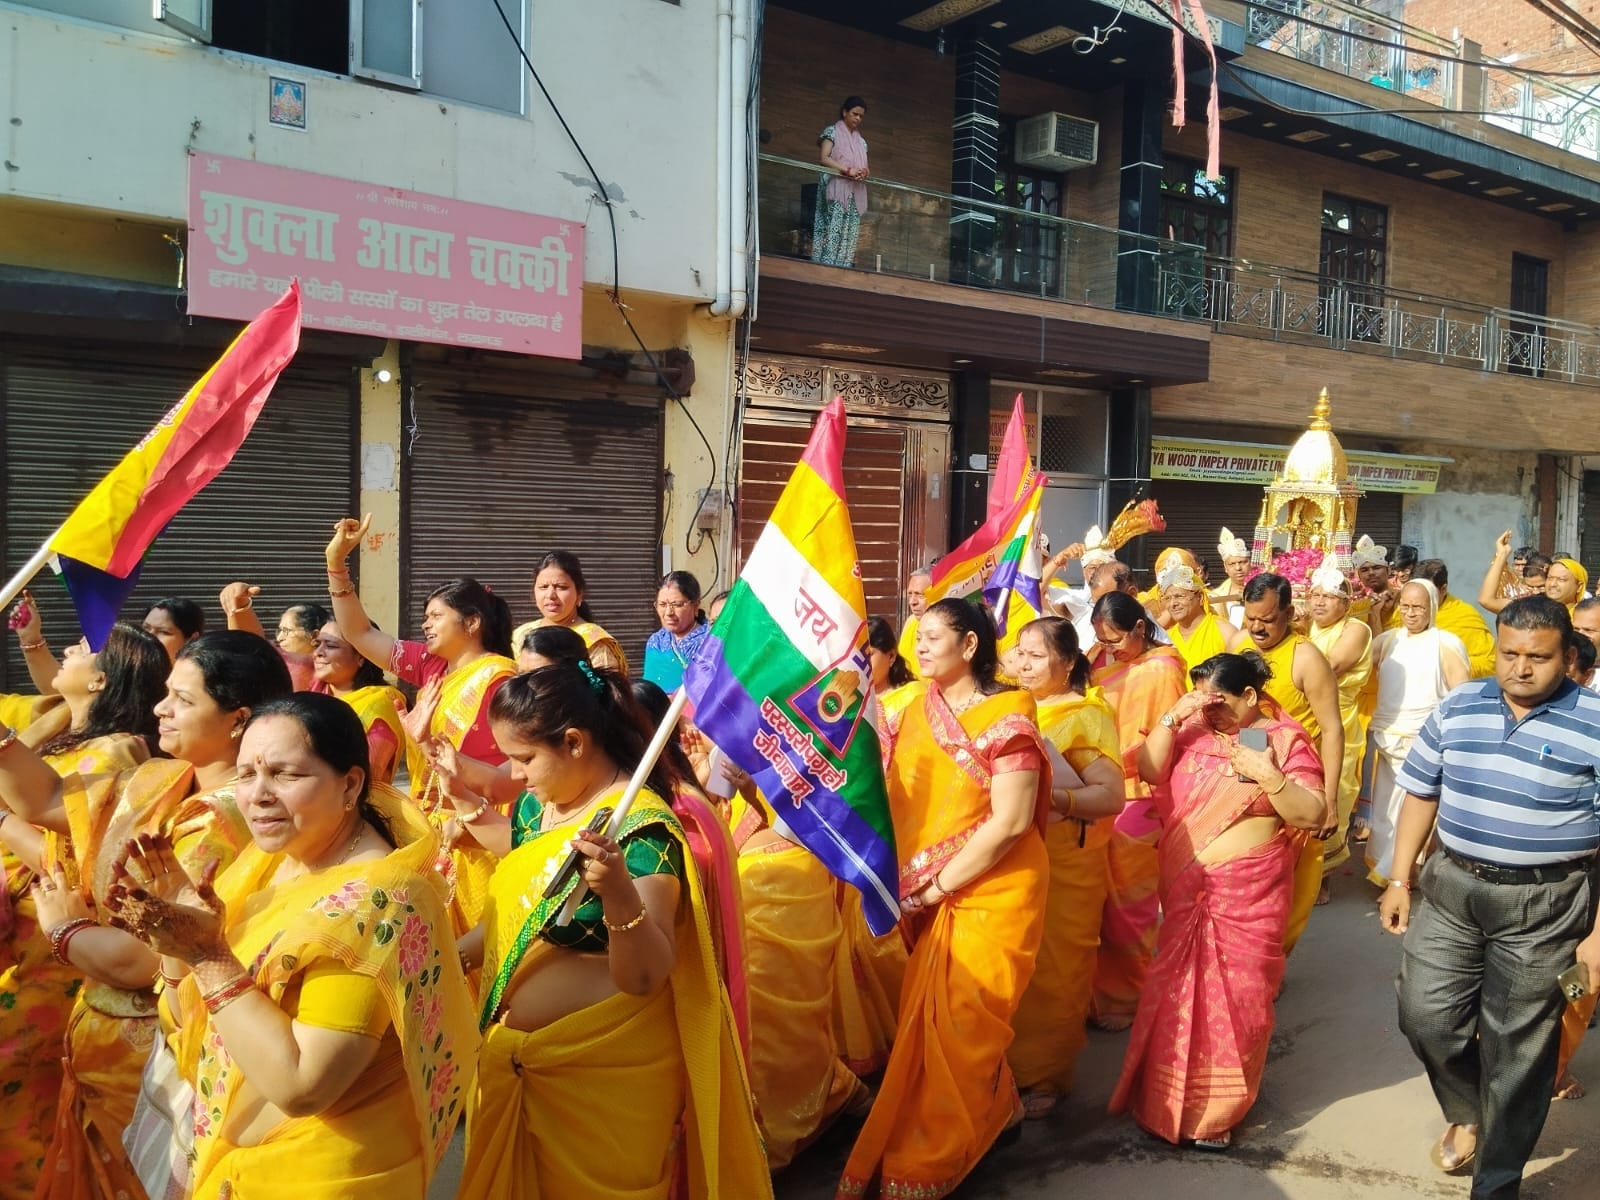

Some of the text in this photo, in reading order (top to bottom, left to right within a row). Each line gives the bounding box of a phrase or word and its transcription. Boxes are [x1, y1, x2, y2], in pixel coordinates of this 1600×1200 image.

[200, 190, 573, 296] शुक्ला आटा चक्की
[208, 268, 257, 291] हमारे
[303, 276, 344, 303] पीली
[399, 296, 424, 313] का
[463, 300, 491, 322] तेल
[495, 309, 548, 329] उपलब्ध
[551, 311, 564, 333] है
[1167, 453, 1197, 468] WOOD
[1198, 455, 1231, 469] IMPEX
[1230, 457, 1269, 472] PRIVATE
[1383, 467, 1412, 481] PRIVATE
[1411, 469, 1438, 482] LIMITED
[795, 586, 838, 645] जय
